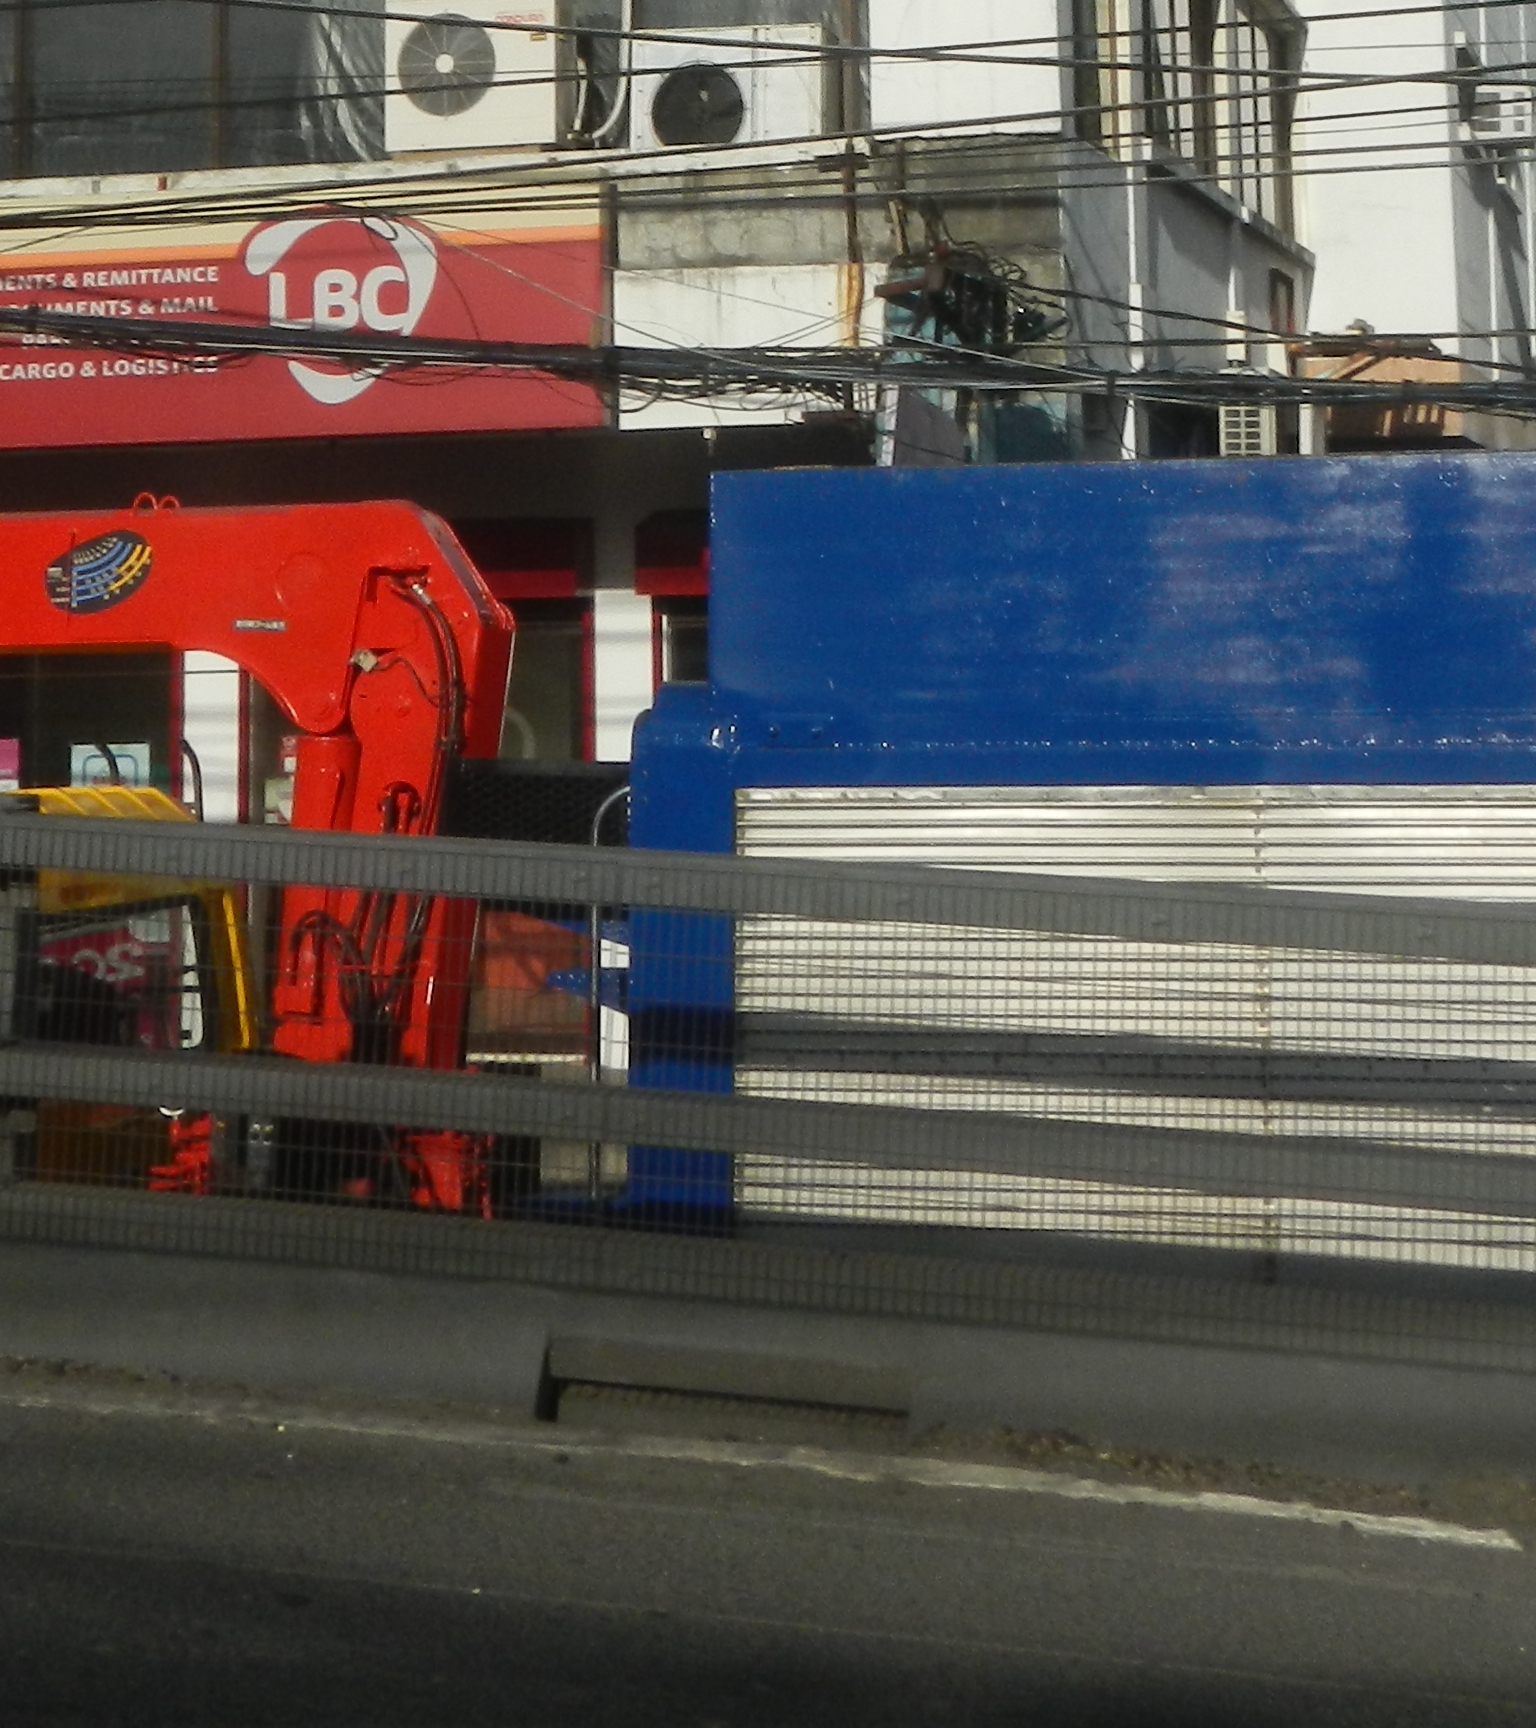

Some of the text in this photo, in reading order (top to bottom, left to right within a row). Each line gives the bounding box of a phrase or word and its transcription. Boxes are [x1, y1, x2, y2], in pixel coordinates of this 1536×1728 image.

[62, 272, 77, 289] &
[82, 266, 220, 288] REMITTANCE
[137, 297, 155, 315] &
[159, 296, 219, 314] MAIL
[267, 265, 410, 334] LBC
[79, 361, 97, 378] &
